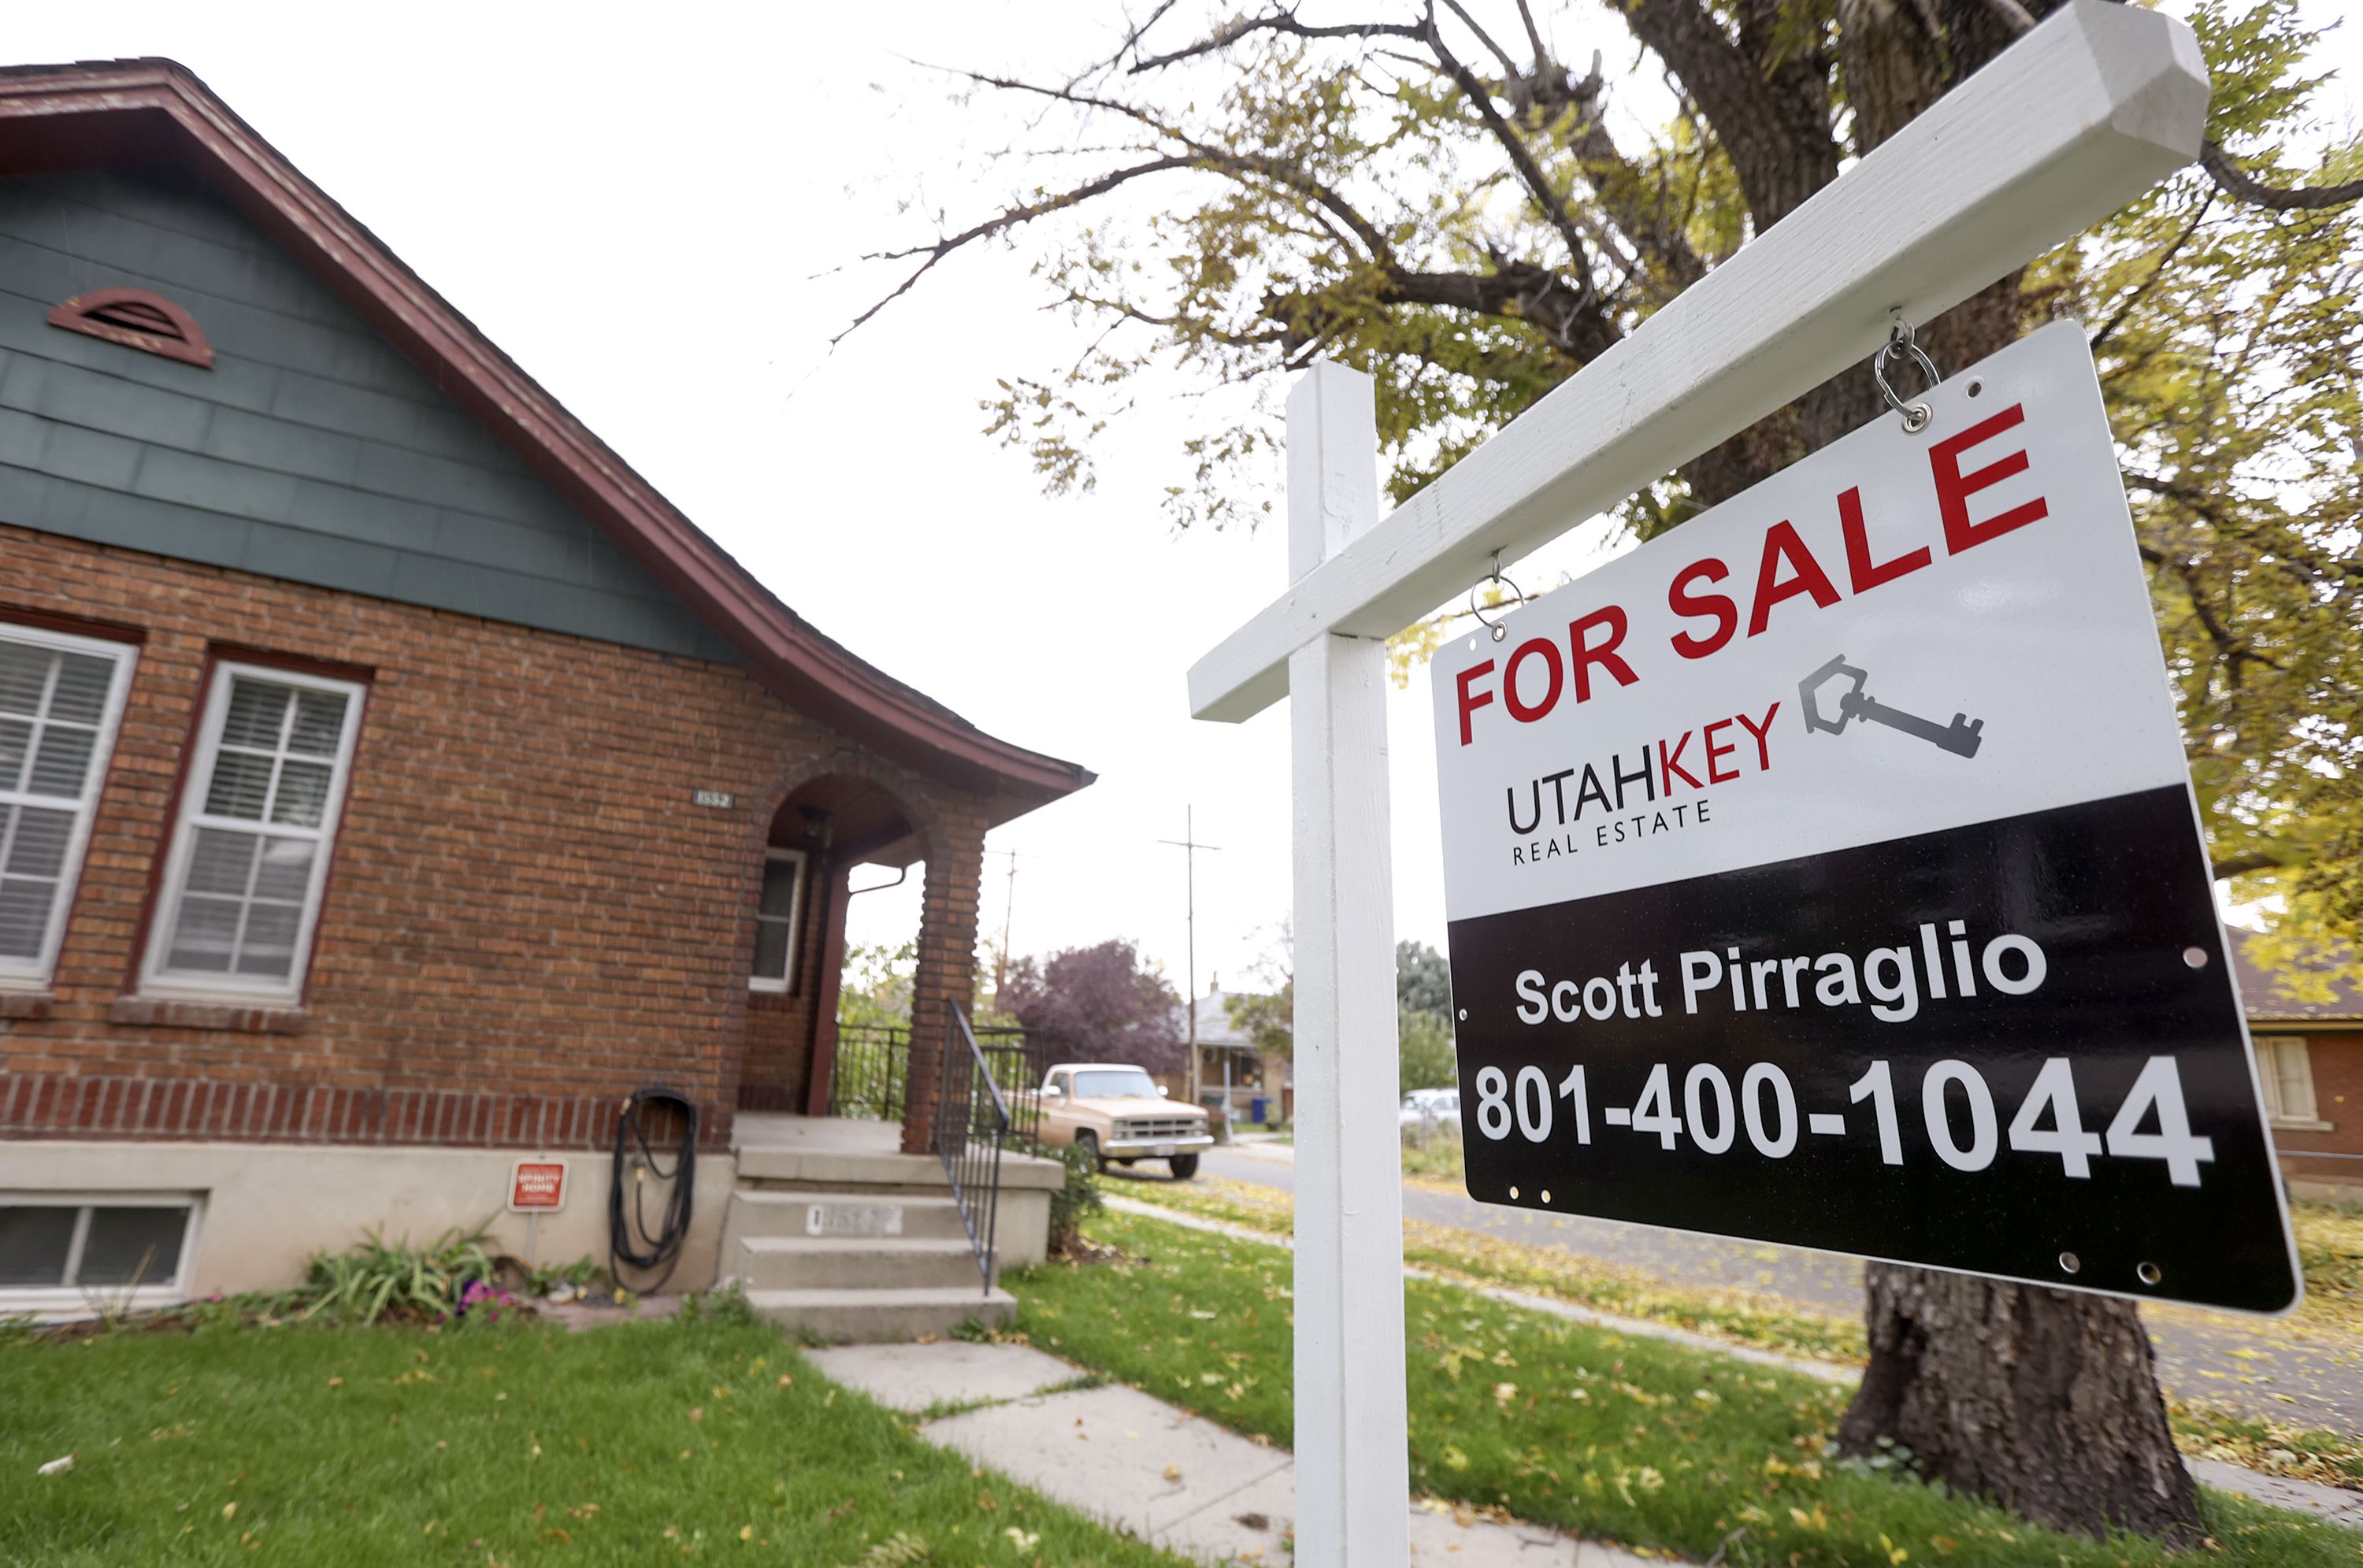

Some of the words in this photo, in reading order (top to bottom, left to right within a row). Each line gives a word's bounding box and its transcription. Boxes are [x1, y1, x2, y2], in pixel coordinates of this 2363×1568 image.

[1456, 604, 1639, 746] FOR
[1668, 402, 2049, 659] SALE
[1506, 701, 1781, 835] UTAHKEY
[1512, 833, 1578, 866] REAL
[1597, 799, 1711, 847] ESTATE
[1515, 958, 1663, 1025] Scott
[1679, 919, 2047, 1023] Pirraglio
[1475, 1055, 2214, 1186] 801-400-1044
